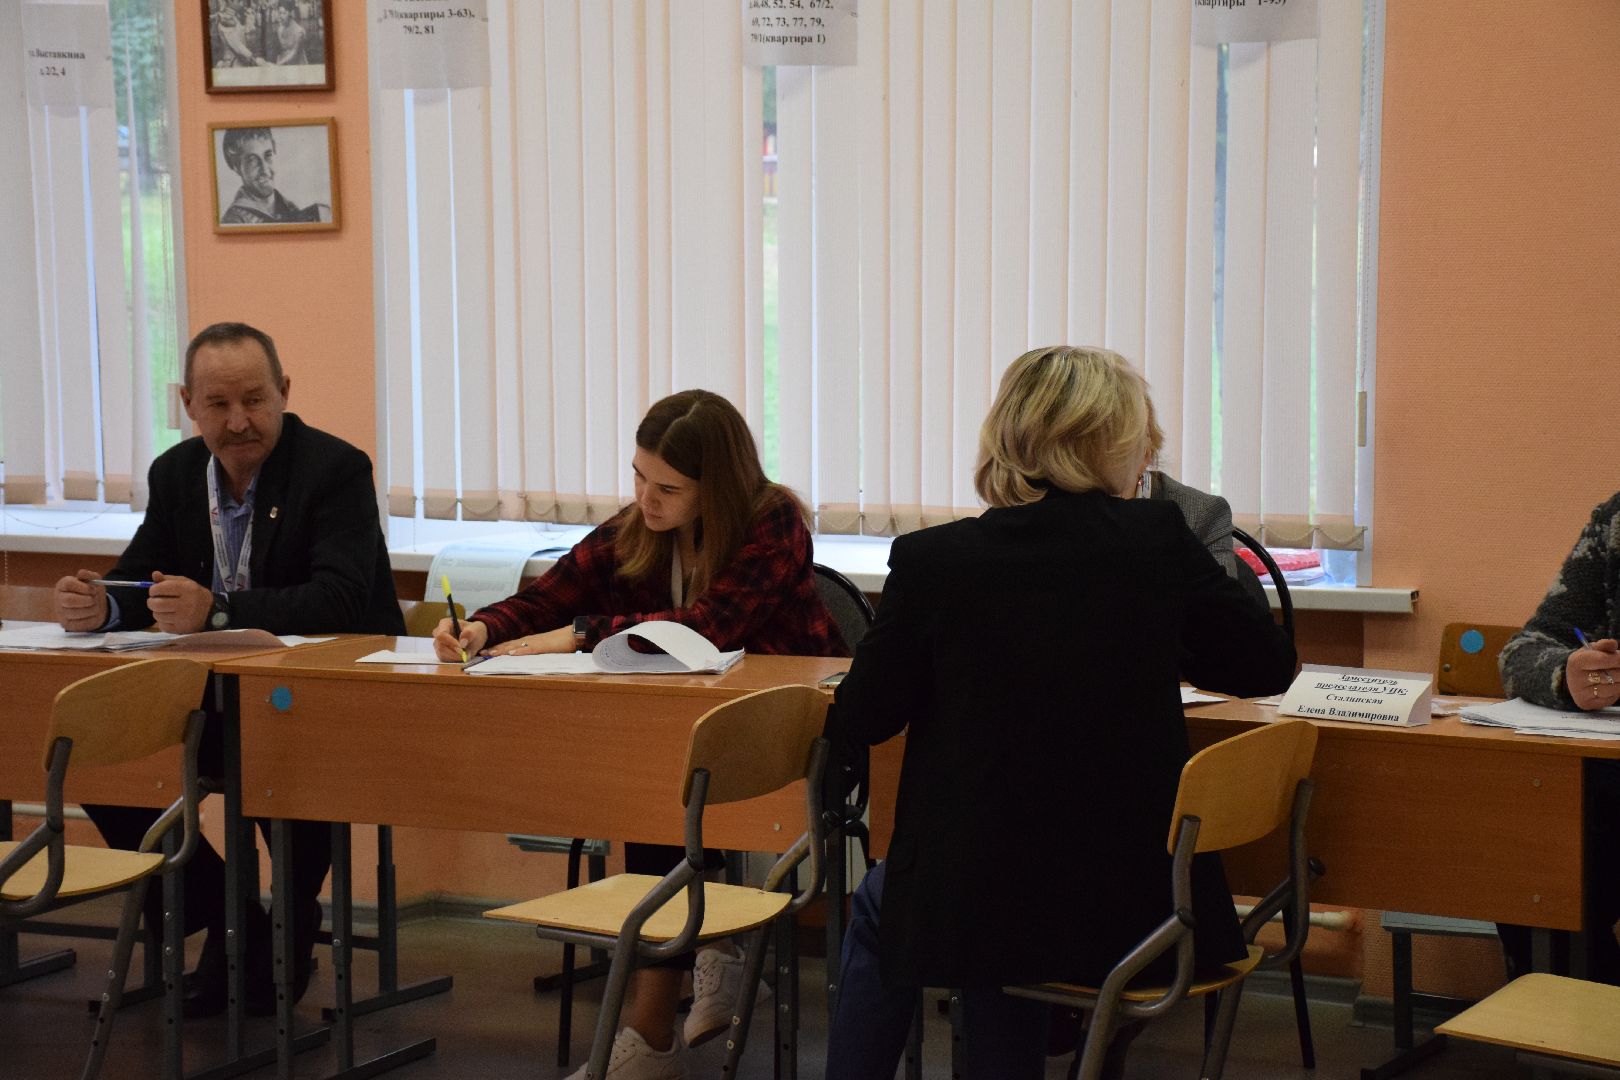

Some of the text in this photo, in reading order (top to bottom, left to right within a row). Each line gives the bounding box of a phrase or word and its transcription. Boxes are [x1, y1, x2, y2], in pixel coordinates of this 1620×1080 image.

[789, 0, 804, 9] 54,
[810, 0, 834, 9] 67/2,
[447, 8, 475, 19] 3-63),
[761, 17, 773, 27] 72,
[775, 17, 789, 27] 73,
[792, 17, 807, 27] 77,
[810, 17, 825, 27] 79,
[424, 25, 435, 35] 81
[1297, 705, 1400, 722] Елена Владимировна
